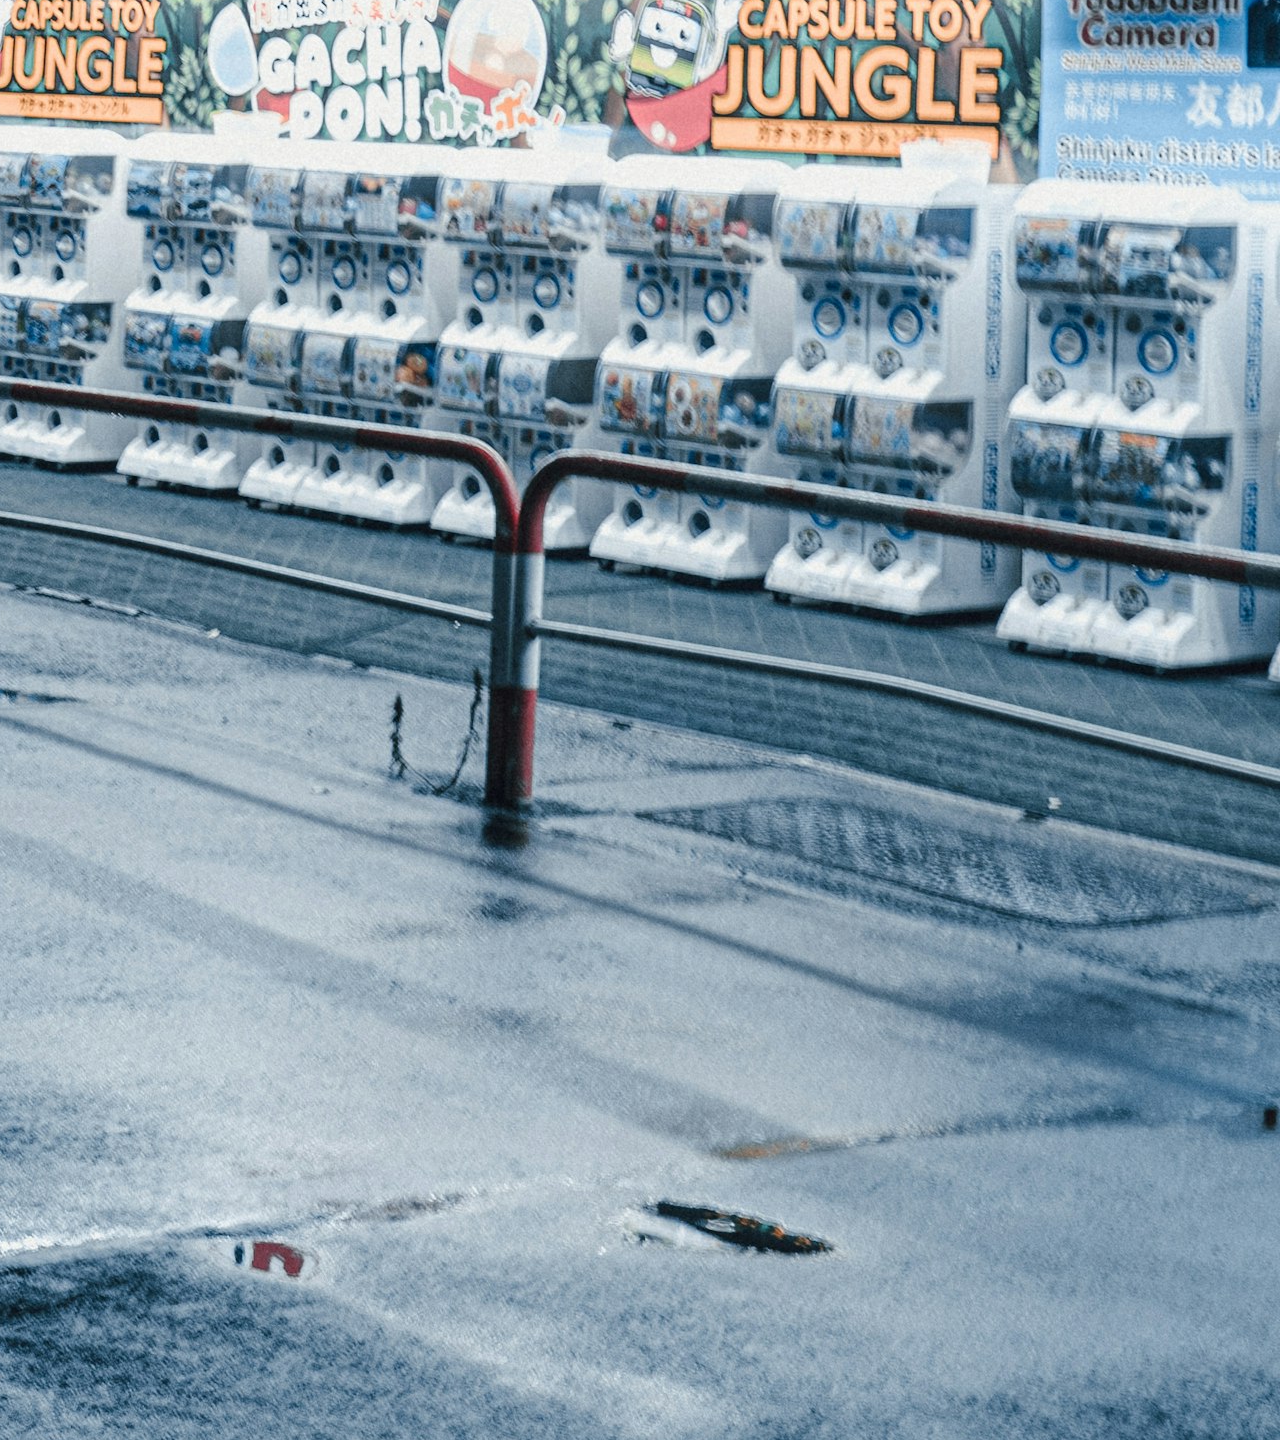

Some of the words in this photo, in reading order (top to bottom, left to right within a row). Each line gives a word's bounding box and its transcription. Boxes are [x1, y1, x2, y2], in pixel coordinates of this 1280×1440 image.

[257, 20, 442, 95] GACHA
[1080, 16, 1219, 49] Camera
[712, 43, 1003, 122] JUNGLE
